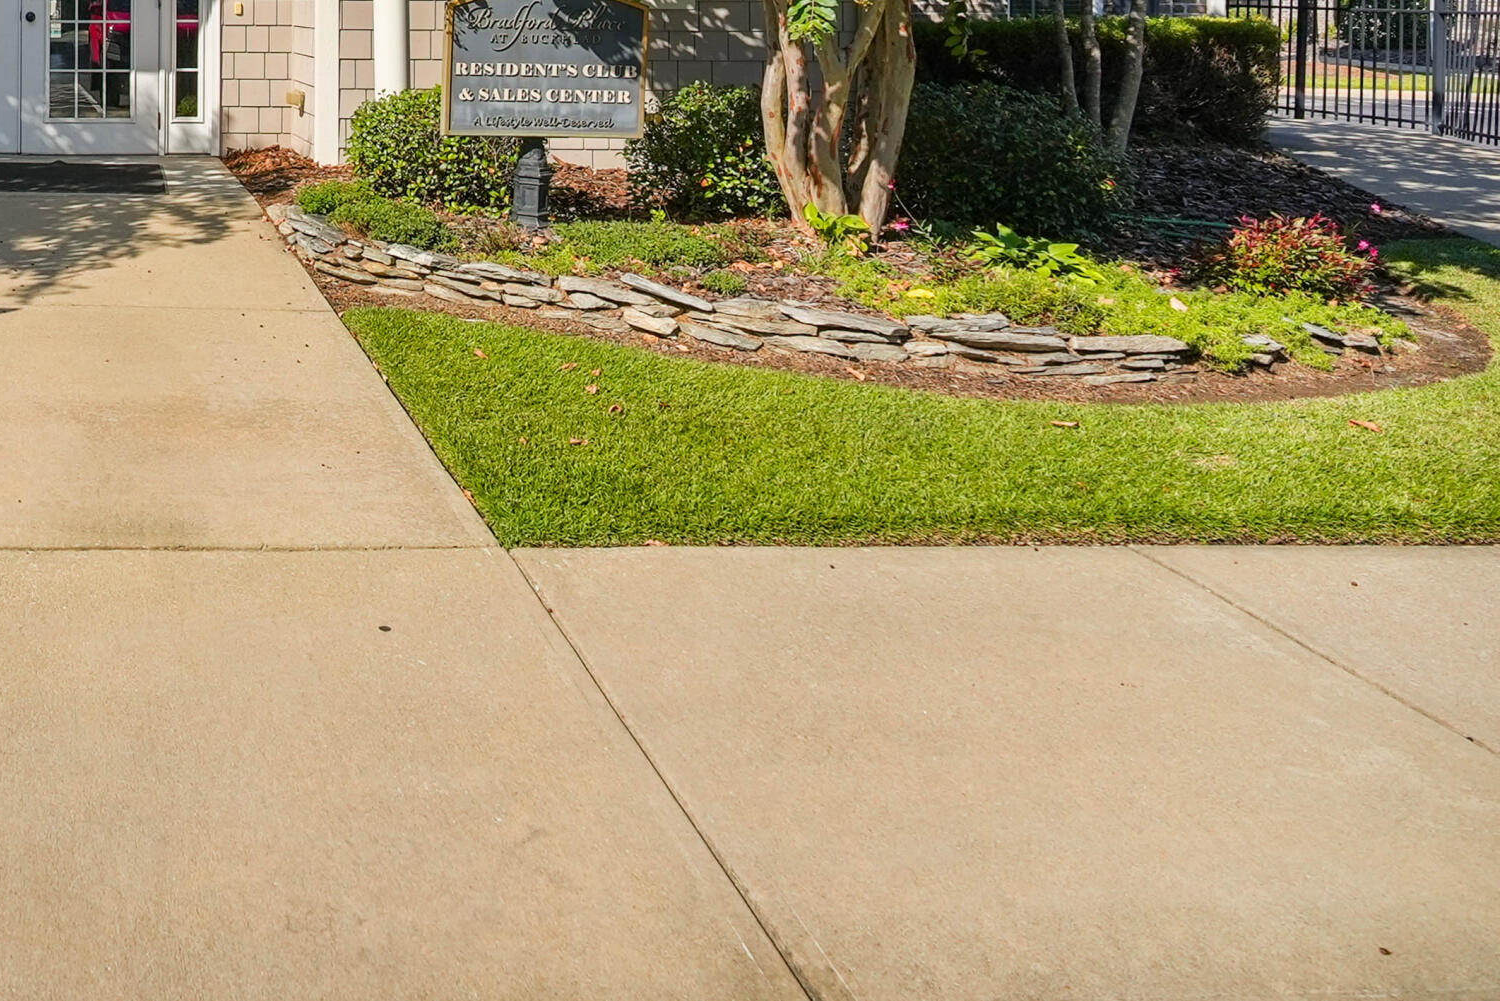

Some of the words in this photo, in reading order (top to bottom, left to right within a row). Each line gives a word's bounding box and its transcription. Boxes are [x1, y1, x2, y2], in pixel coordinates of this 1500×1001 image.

[467, 0, 561, 52] Bradford
[490, 34, 508, 45] AT
[455, 62, 579, 79] RESIDENT'S
[582, 64, 639, 80] CLUB
[458, 87, 475, 102] &
[478, 87, 542, 103] SALES
[545, 89, 633, 105] CENTER
[473, 116, 482, 127] A
[486, 116, 532, 130] Lifestyle
